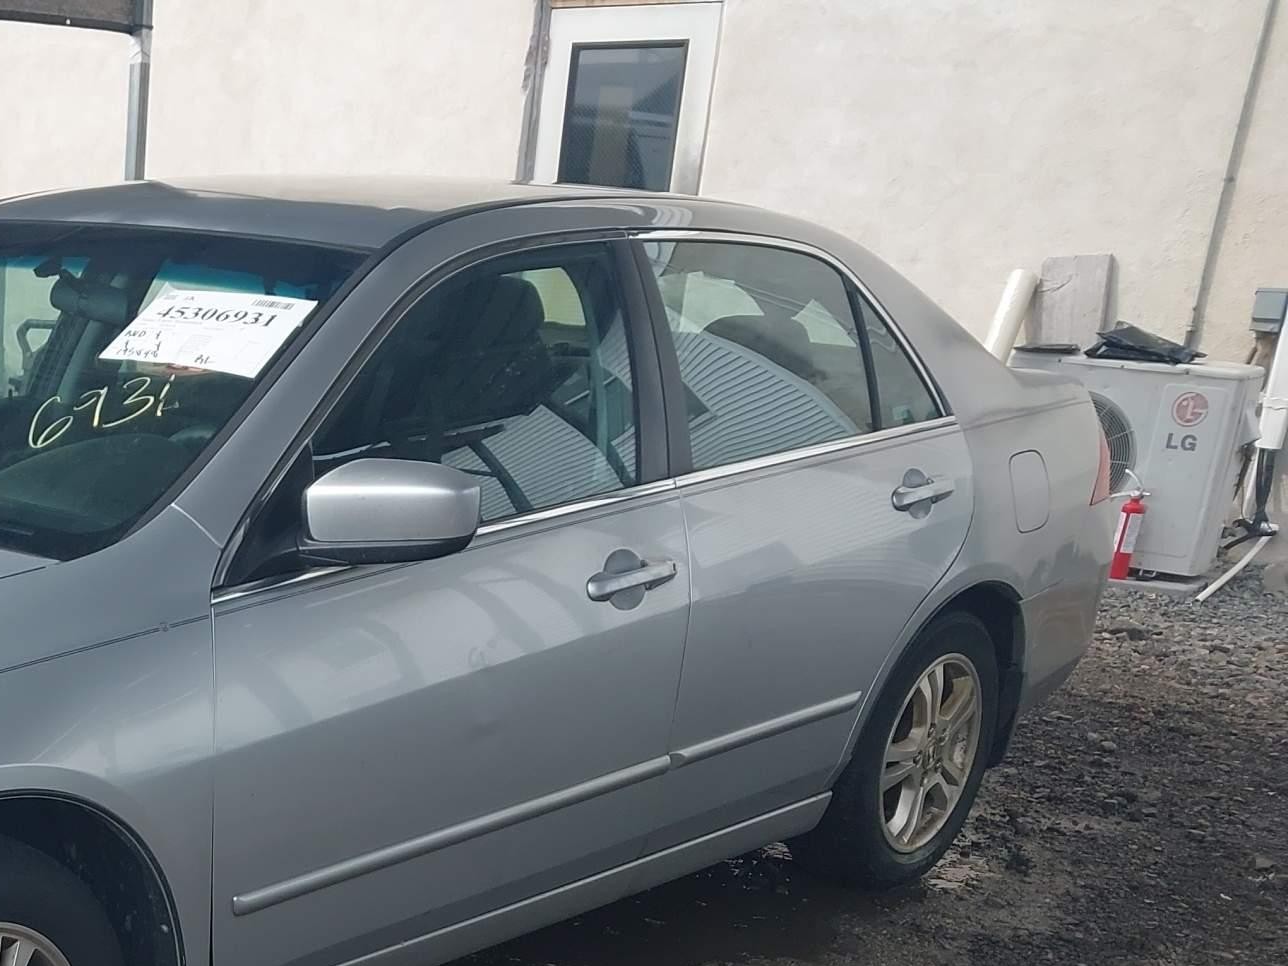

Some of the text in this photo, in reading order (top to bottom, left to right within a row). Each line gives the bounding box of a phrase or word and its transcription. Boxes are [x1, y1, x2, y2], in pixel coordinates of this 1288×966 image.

[156, 305, 278, 327] 45306931
[28, 373, 179, 449] 6931
[1165, 432, 1198, 452] LG
